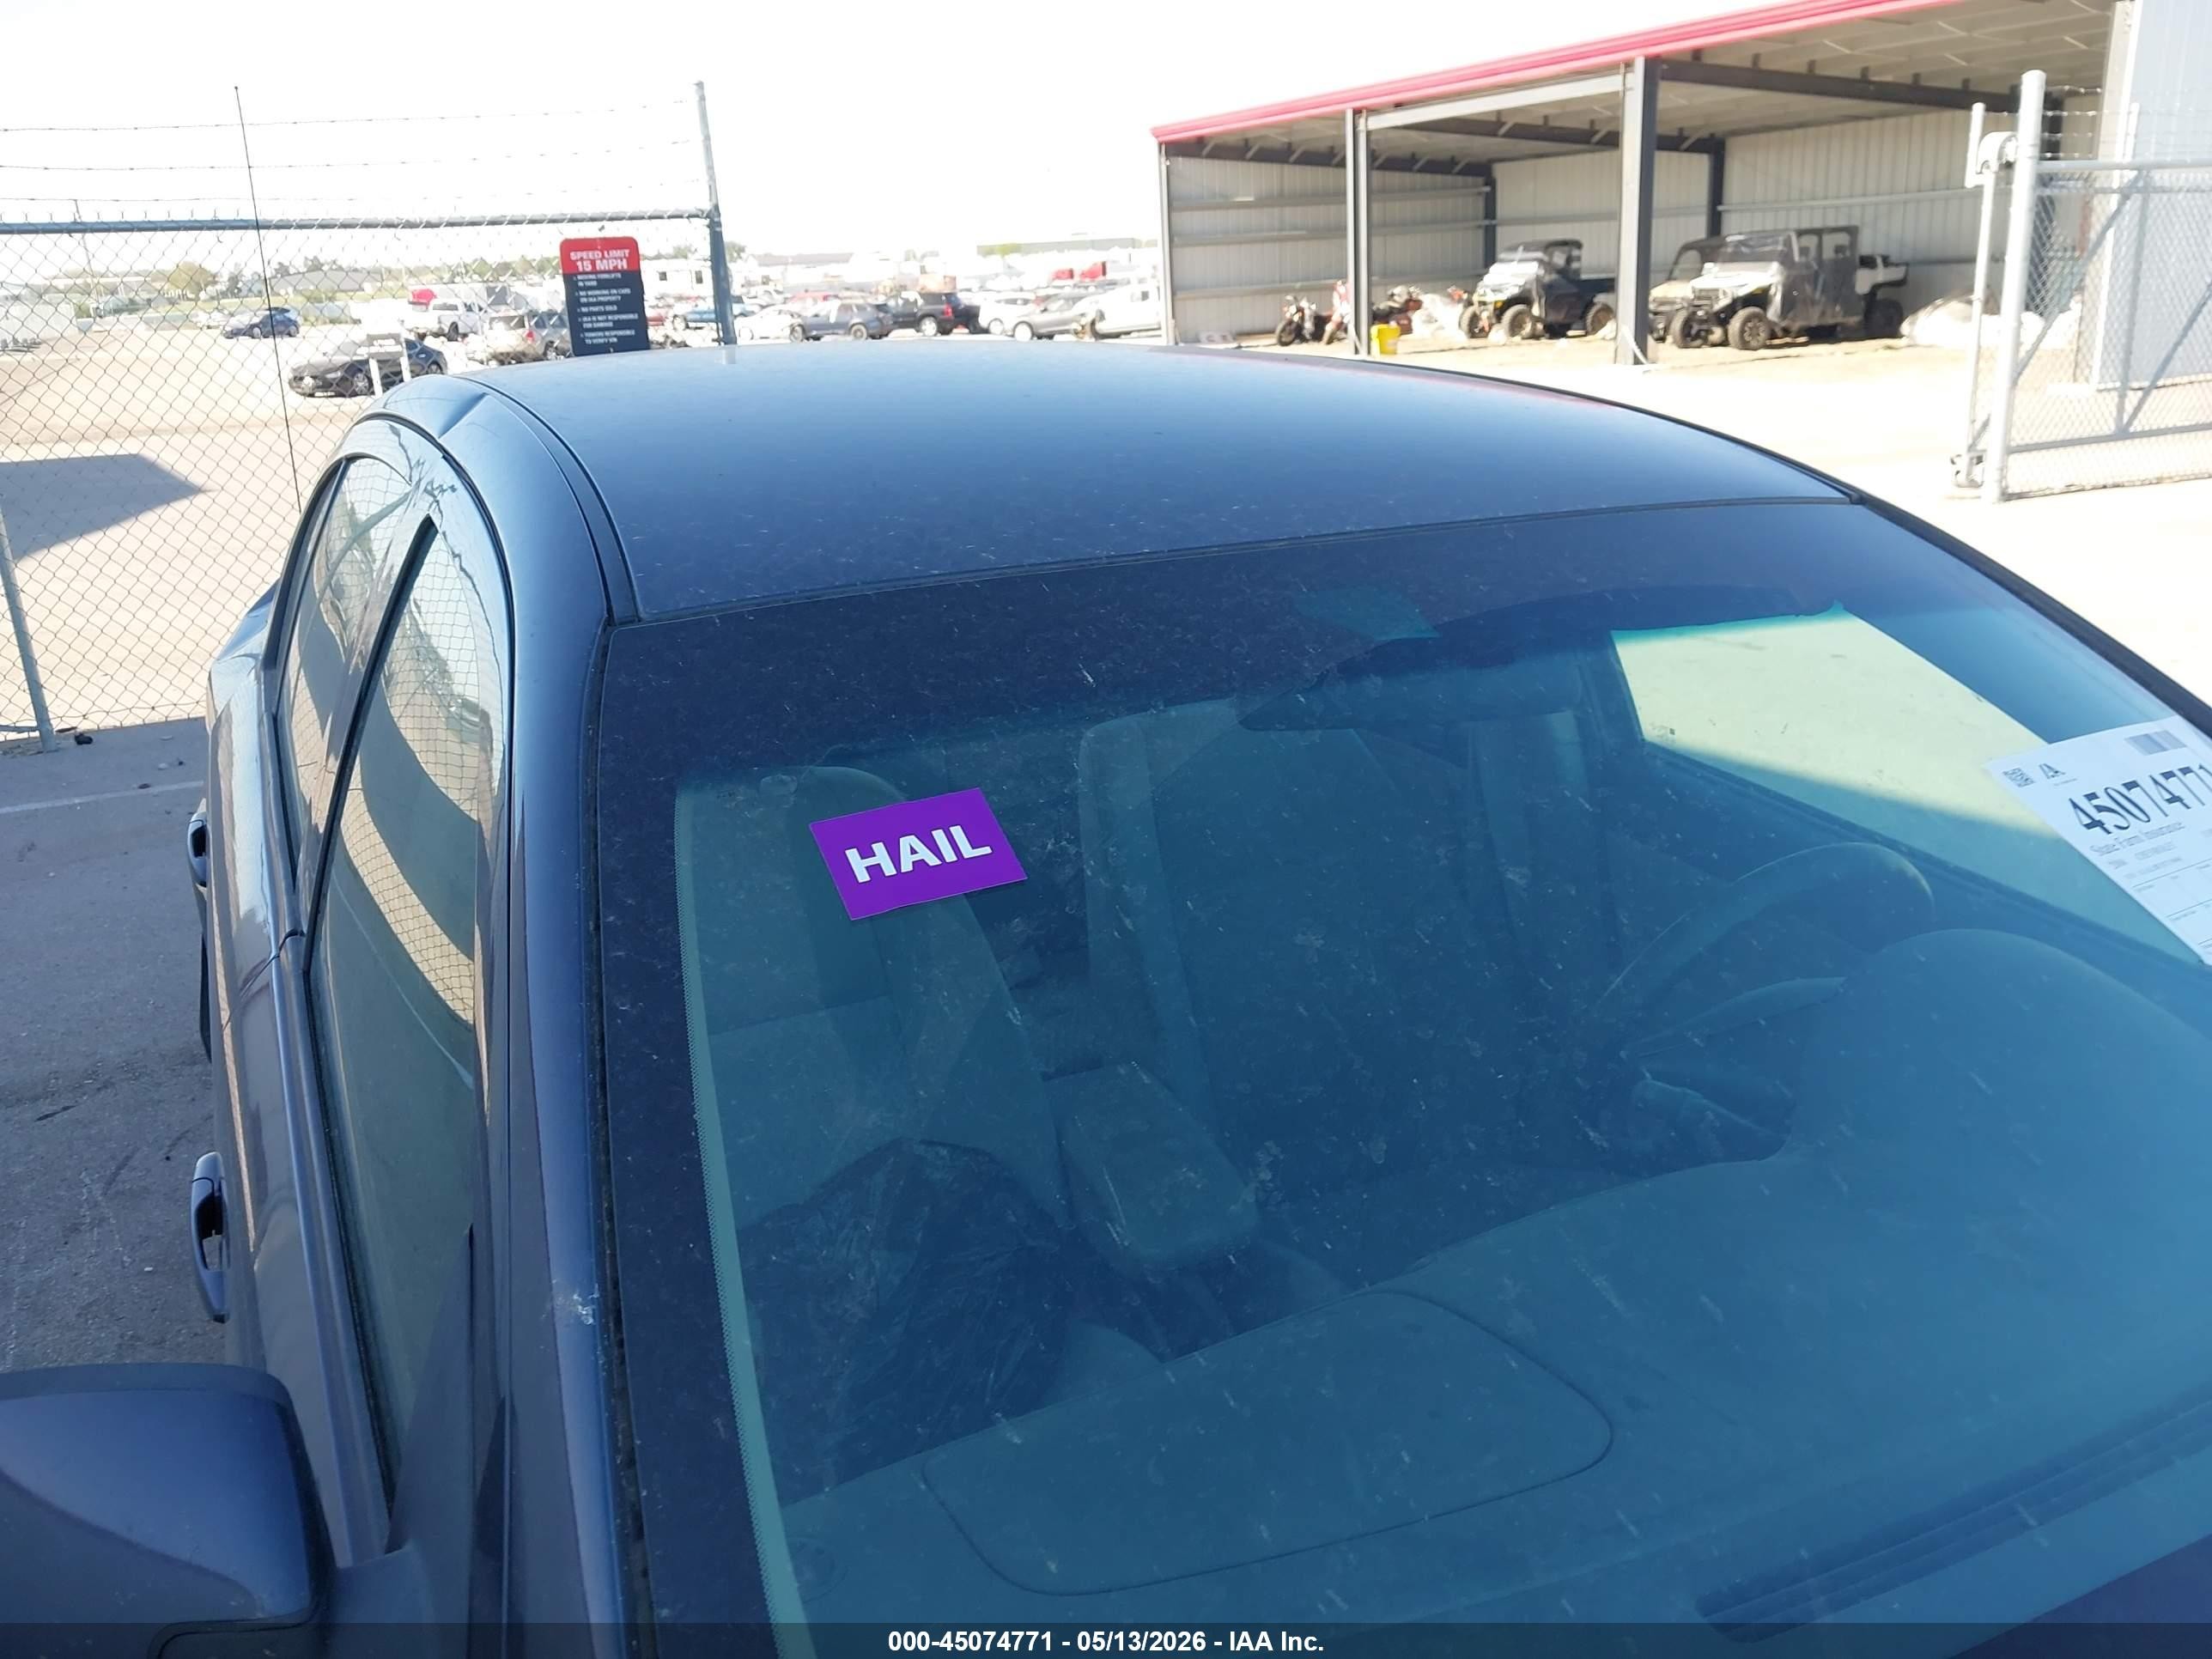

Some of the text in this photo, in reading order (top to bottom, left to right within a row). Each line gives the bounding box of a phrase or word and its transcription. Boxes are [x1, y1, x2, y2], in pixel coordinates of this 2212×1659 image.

[570, 249, 629, 260] SPEED LIMIT
[576, 258, 628, 271] 15 MPH
[845, 825, 993, 883] HAIL
